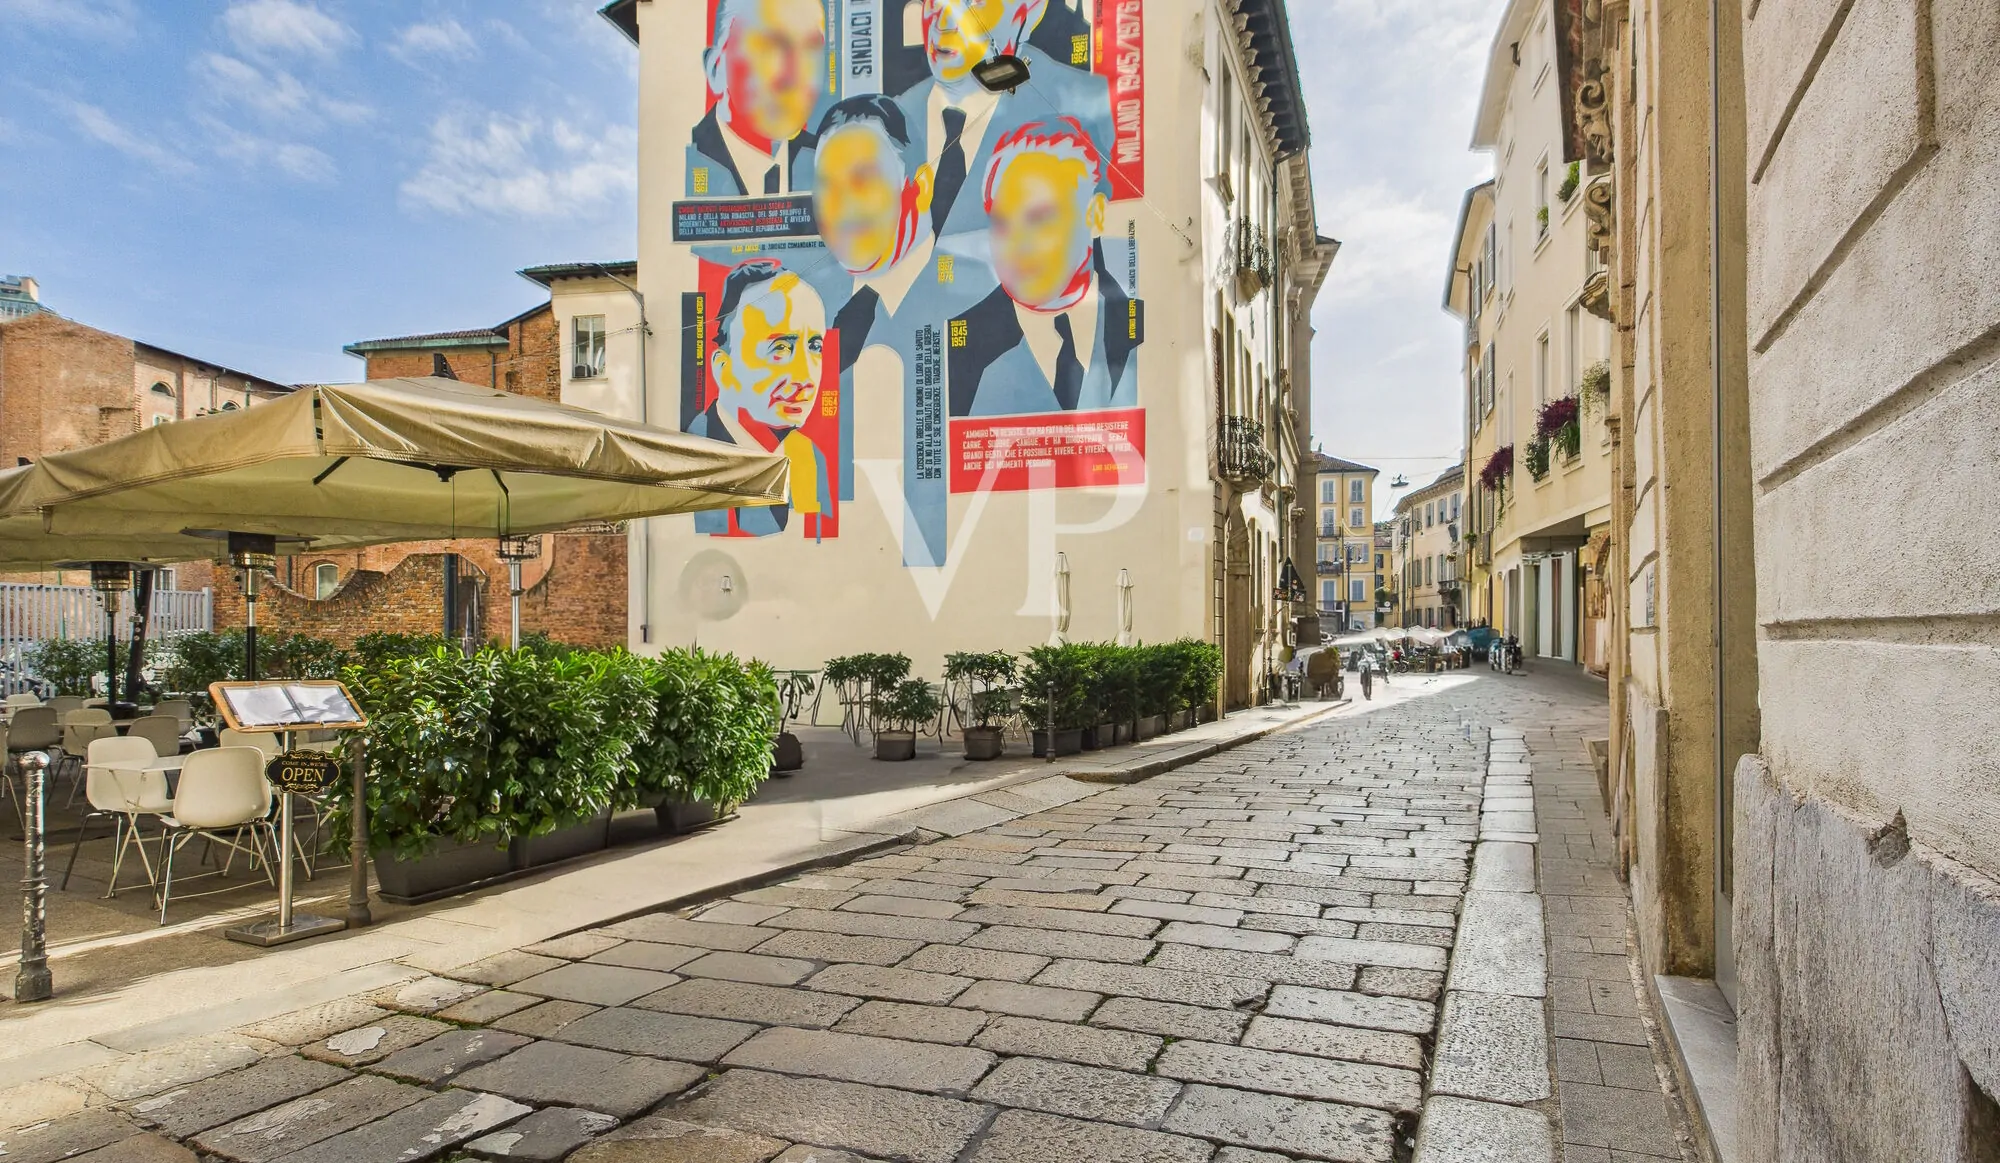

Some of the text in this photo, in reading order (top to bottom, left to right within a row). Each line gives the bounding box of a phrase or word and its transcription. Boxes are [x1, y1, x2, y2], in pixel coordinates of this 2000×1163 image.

[851, 11, 873, 76] SINDACI
[1072, 51, 1088, 64] 1964
[1116, 1, 1141, 164] MILANO 1945/1976
[952, 326, 968, 336] 1945
[952, 336, 966, 347] 1951
[822, 396, 838, 406] 1964
[822, 406, 838, 416] 1967
[933, 426, 941, 437] SUE
[1045, 437, 1048, 445] E
[933, 449, 941, 465] TUTTE
[1005, 449, 1017, 458] CHE
[1078, 446, 1083, 454] E
[964, 462, 982, 470] ANCHE
[933, 468, 941, 478] CON
[282, 767, 326, 782] OPEN
